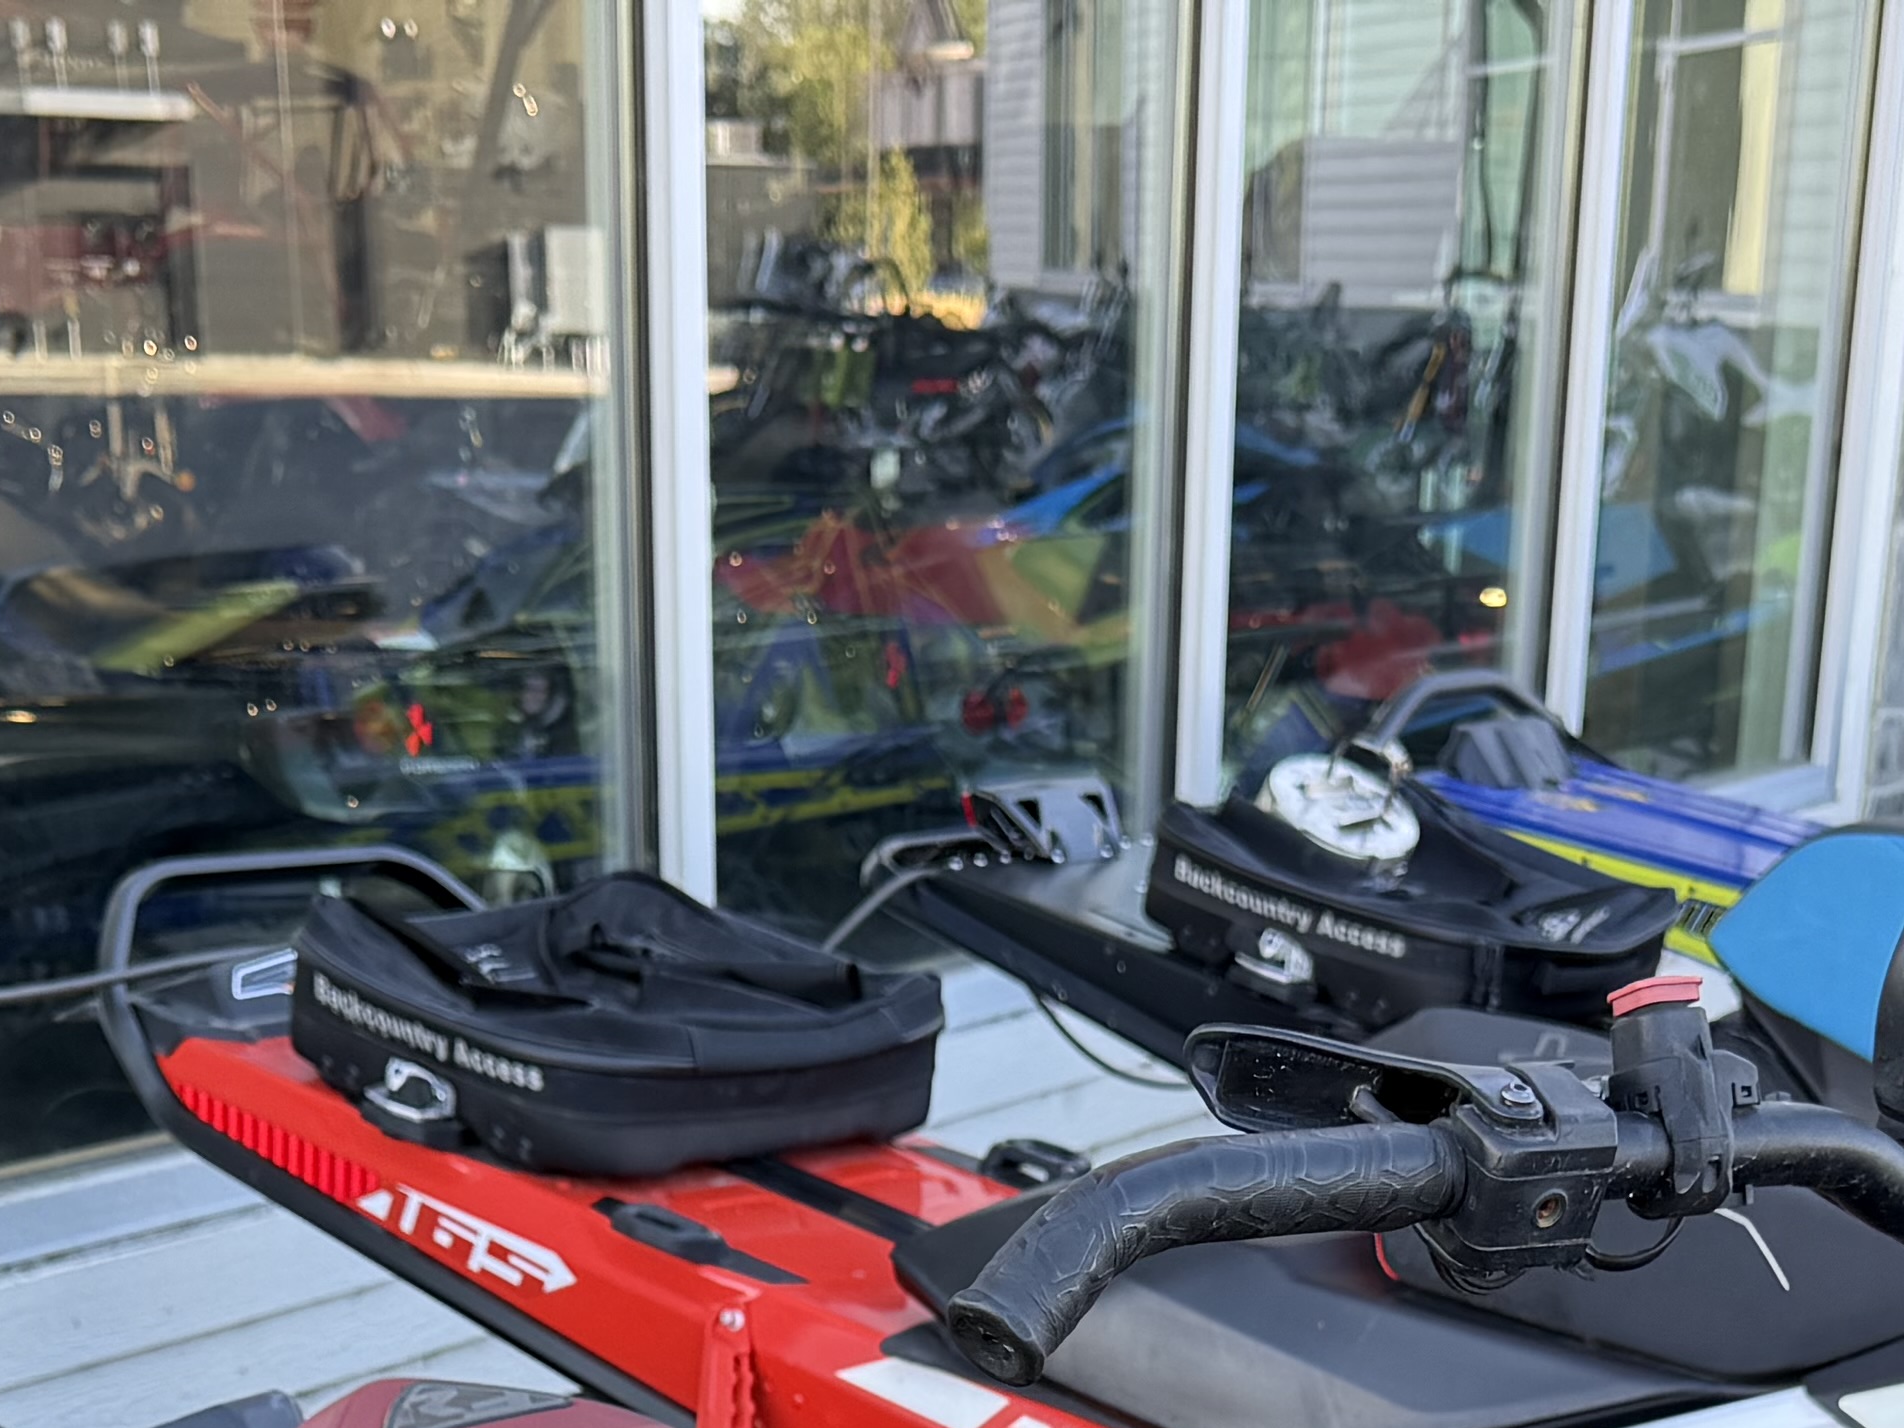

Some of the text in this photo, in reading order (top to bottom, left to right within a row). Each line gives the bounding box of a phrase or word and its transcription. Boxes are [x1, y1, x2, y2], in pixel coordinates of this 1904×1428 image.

[1174, 853, 1406, 958] Backcountry Access
[313, 970, 544, 1092] Backcountry Access
